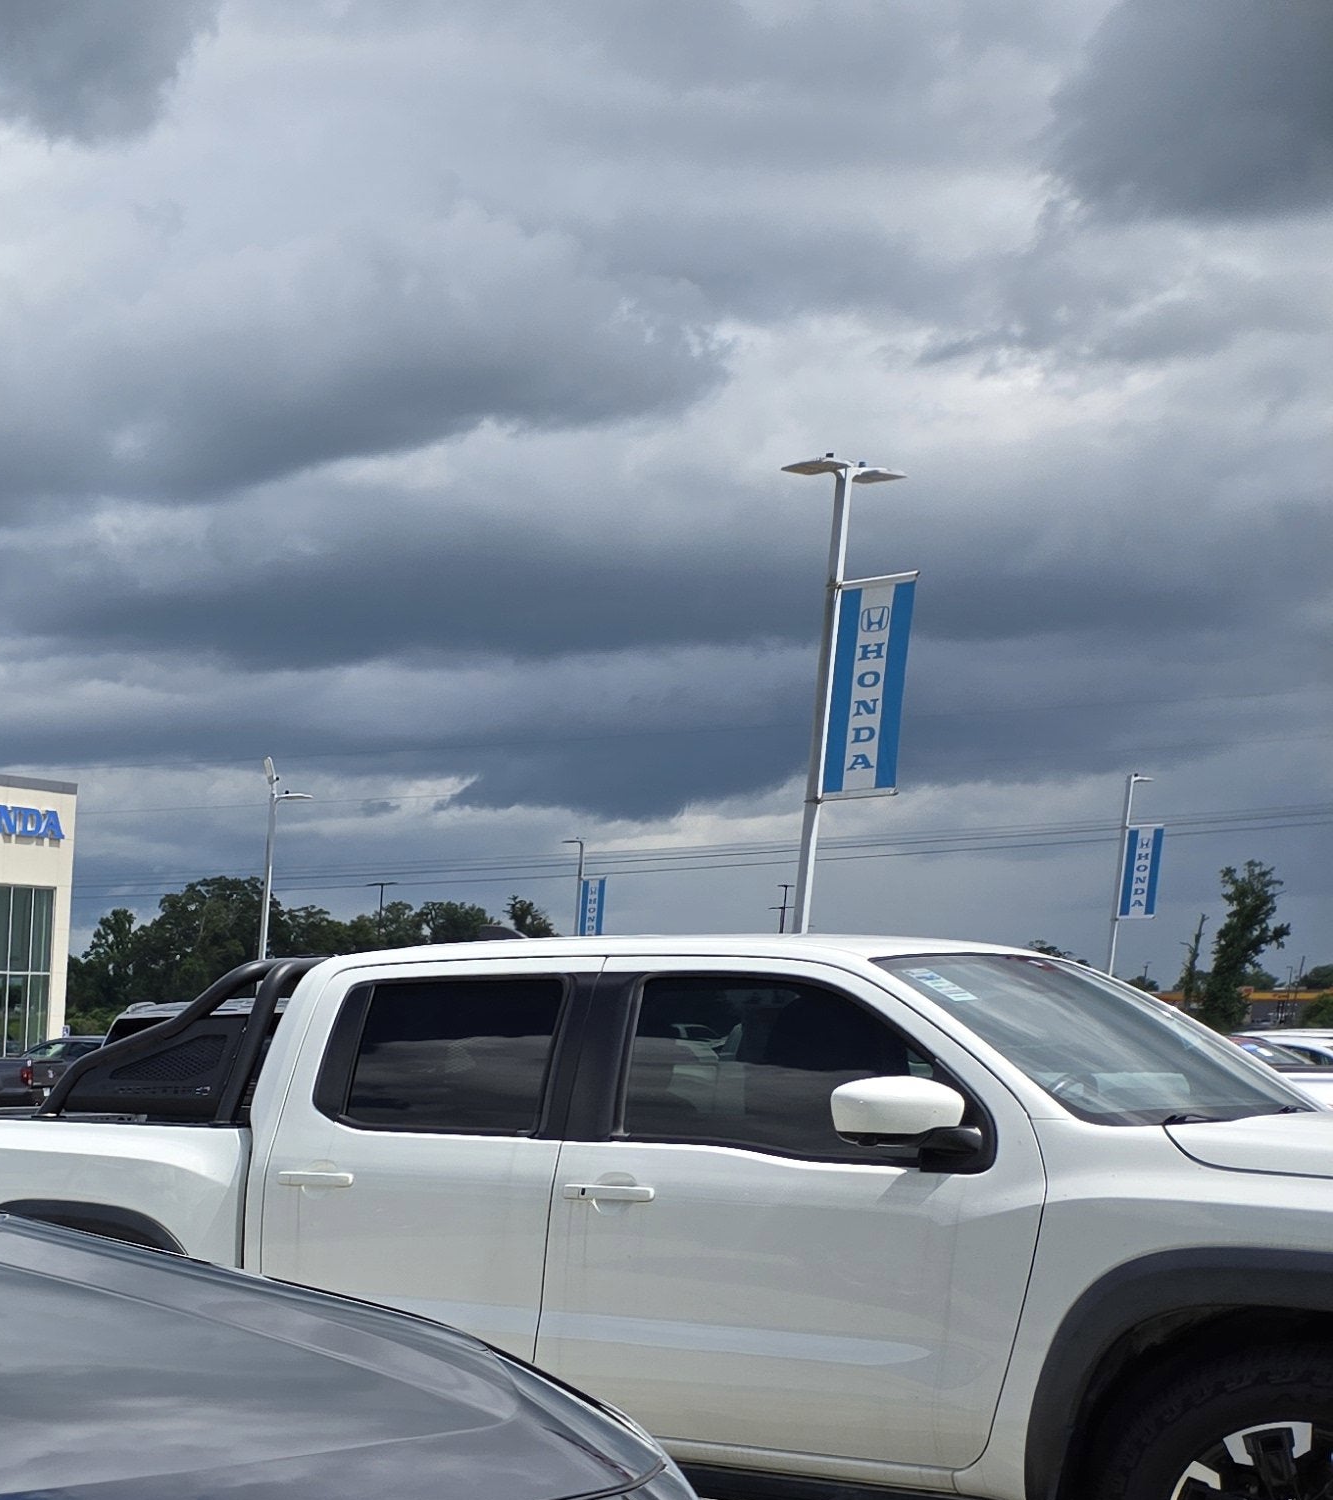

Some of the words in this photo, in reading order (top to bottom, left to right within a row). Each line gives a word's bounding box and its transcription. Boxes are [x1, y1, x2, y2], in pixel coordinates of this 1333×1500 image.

[846, 641, 886, 771] HONDA
[1131, 852, 1150, 907] HONDA
[587, 897, 597, 935] HOND
